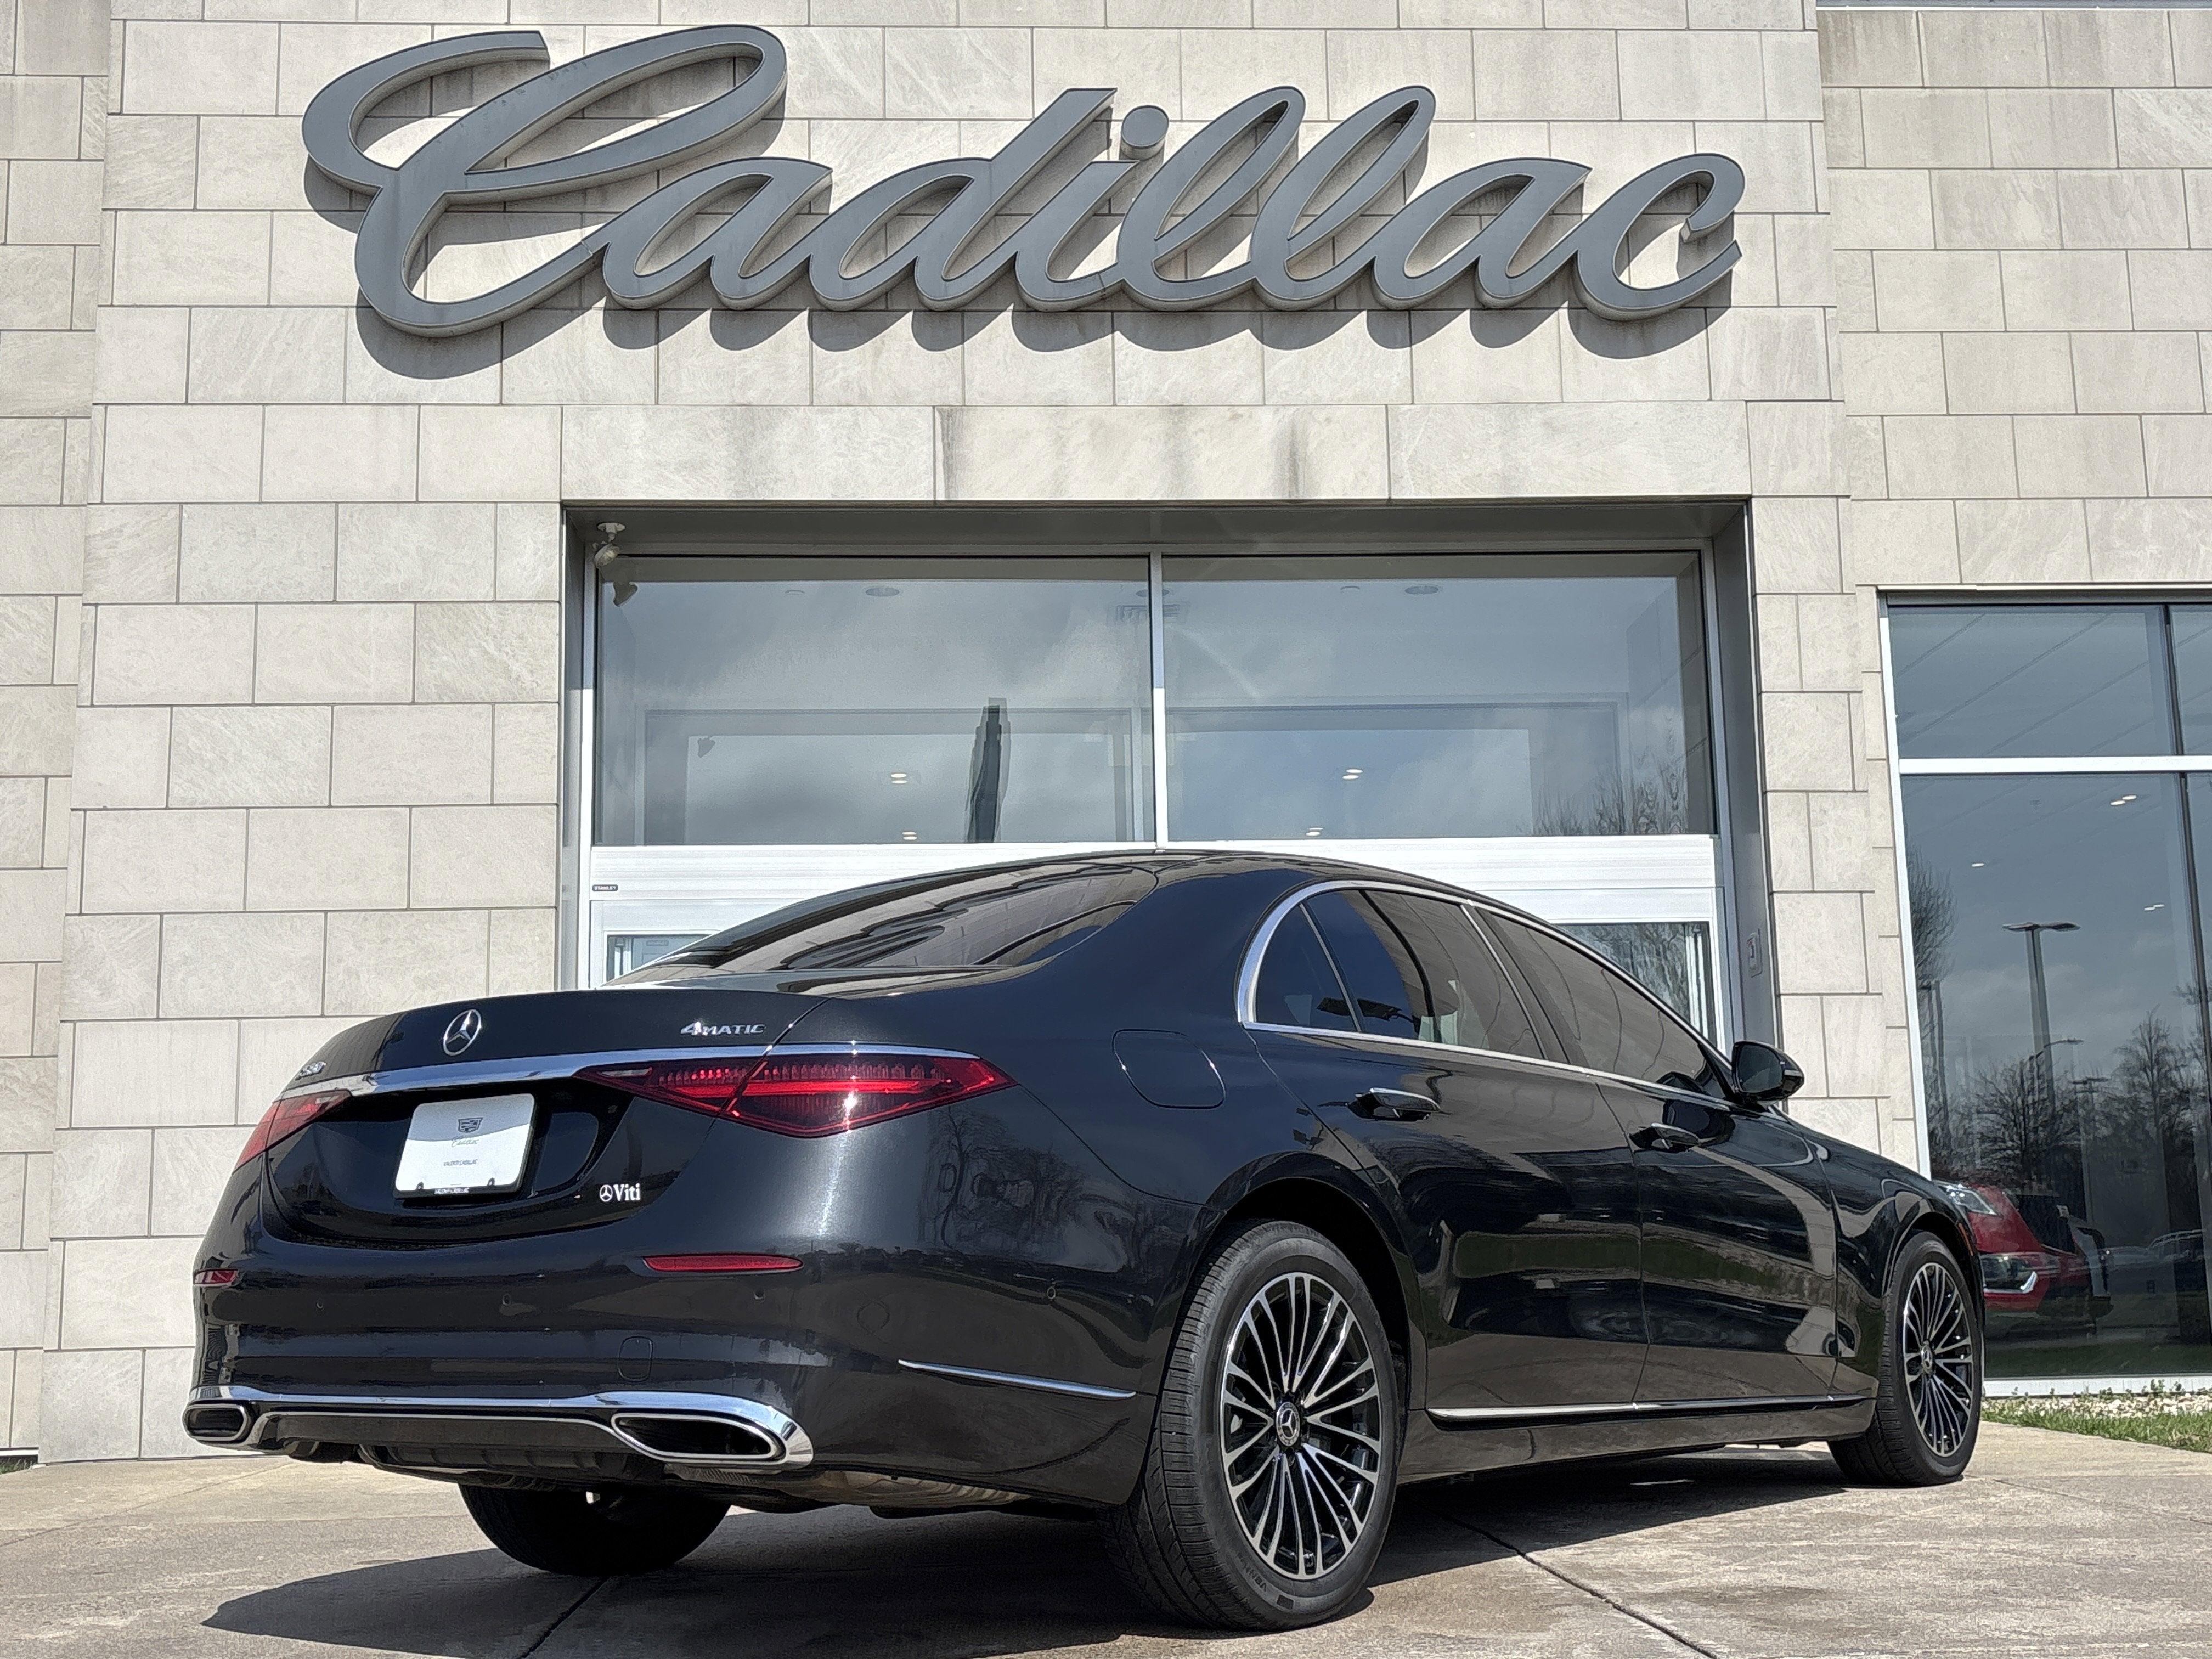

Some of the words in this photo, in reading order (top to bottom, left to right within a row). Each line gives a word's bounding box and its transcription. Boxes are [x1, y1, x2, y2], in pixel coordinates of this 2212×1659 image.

[303, 25, 1747, 337] Cadillac
[680, 1021, 766, 1036] 4MATIC
[613, 1183, 641, 1201] Viti
